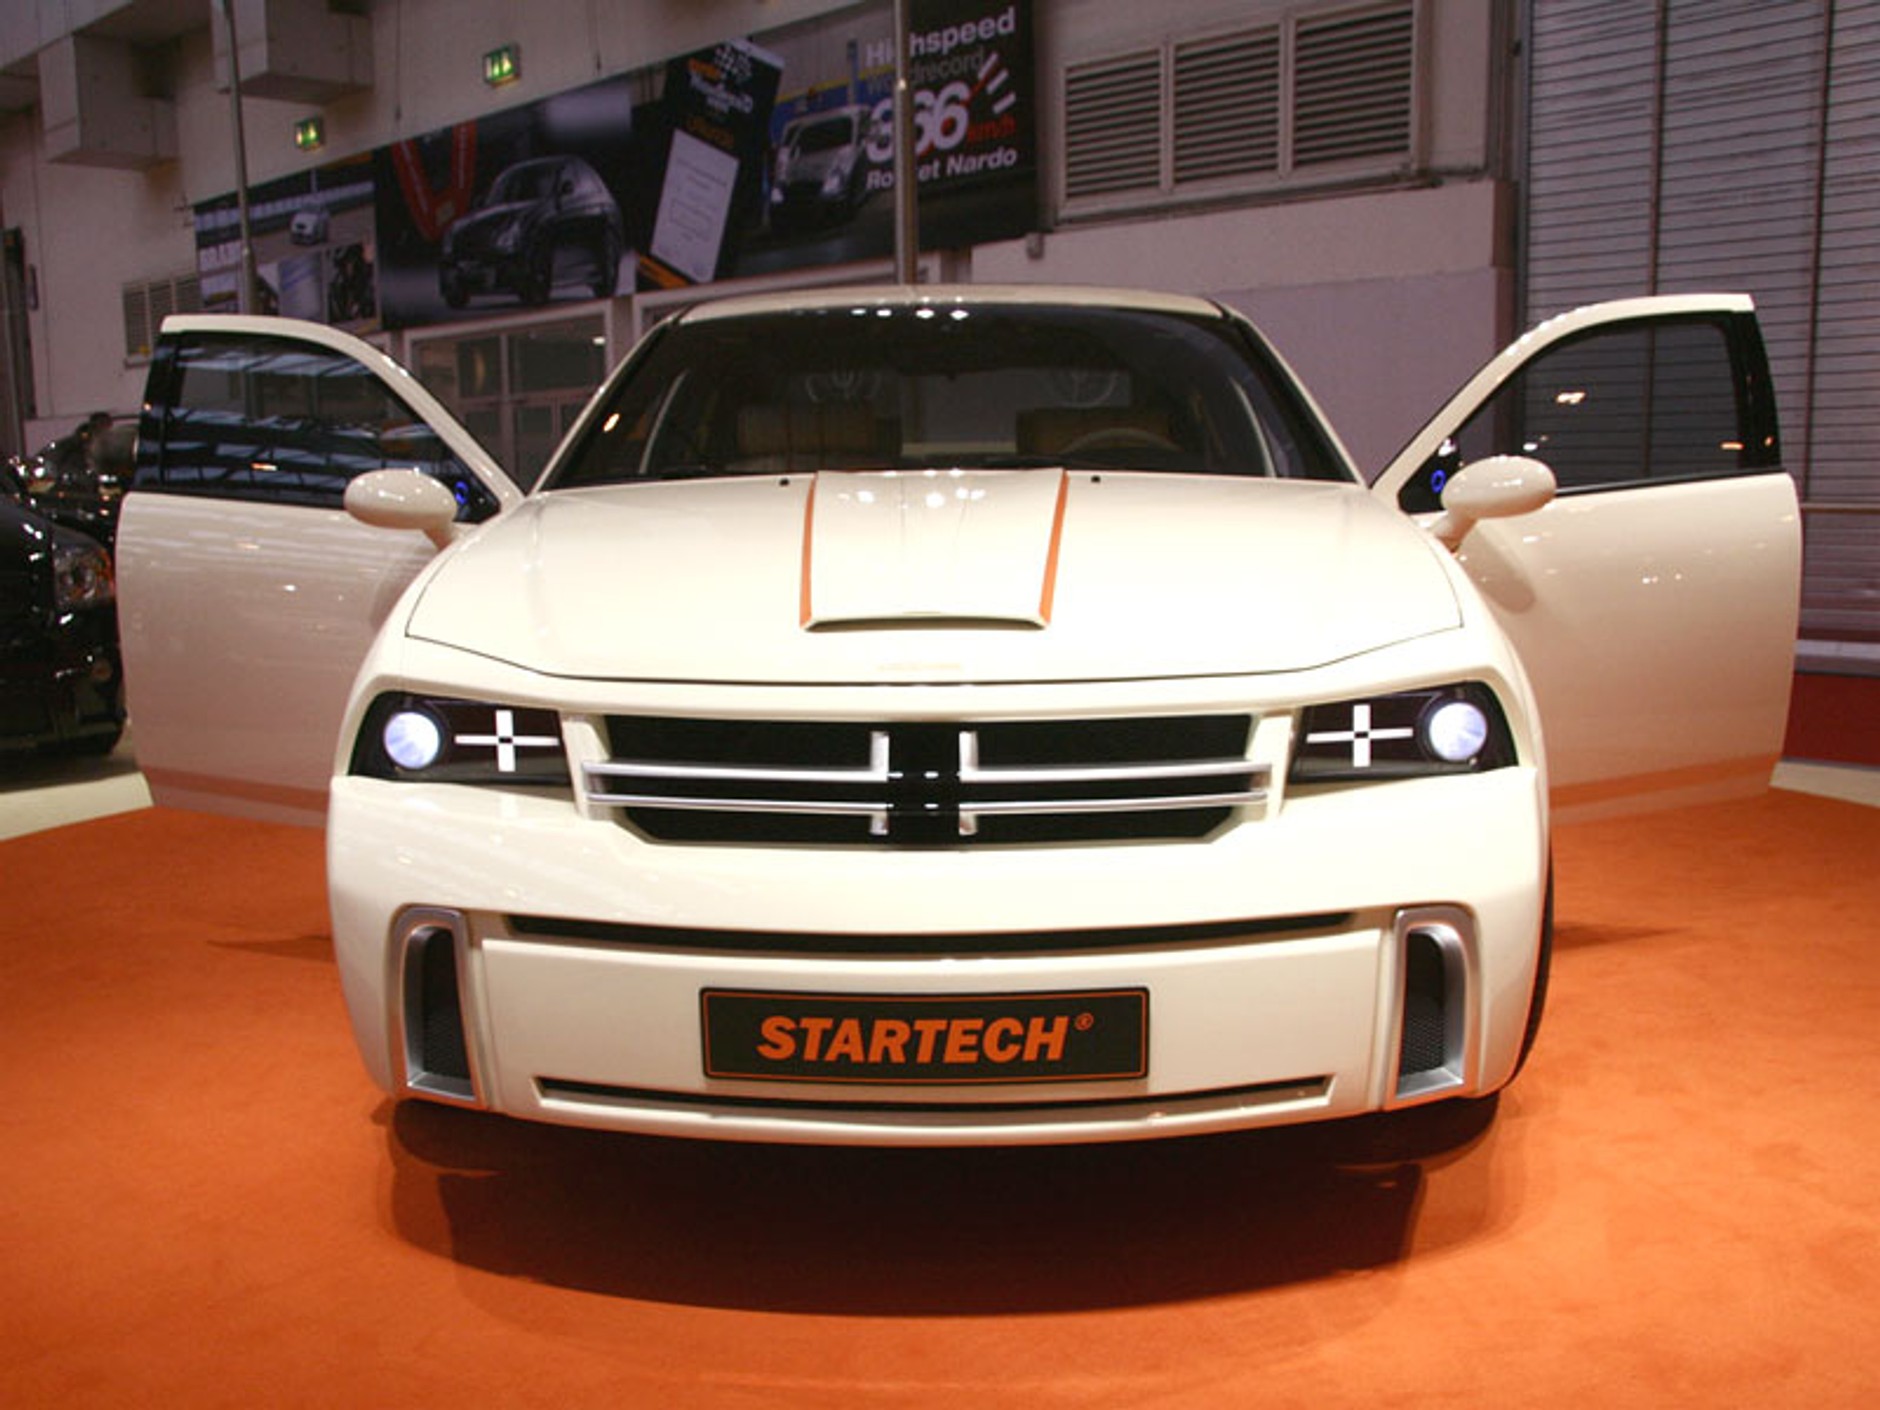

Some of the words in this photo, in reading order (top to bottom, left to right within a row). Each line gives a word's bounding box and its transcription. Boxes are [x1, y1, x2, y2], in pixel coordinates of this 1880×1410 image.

[866, 7, 1016, 66] Hihspeed
[866, 160, 940, 190] Roet
[946, 147, 1017, 175] Nardo
[756, 1016, 1068, 1064] STARTECH
